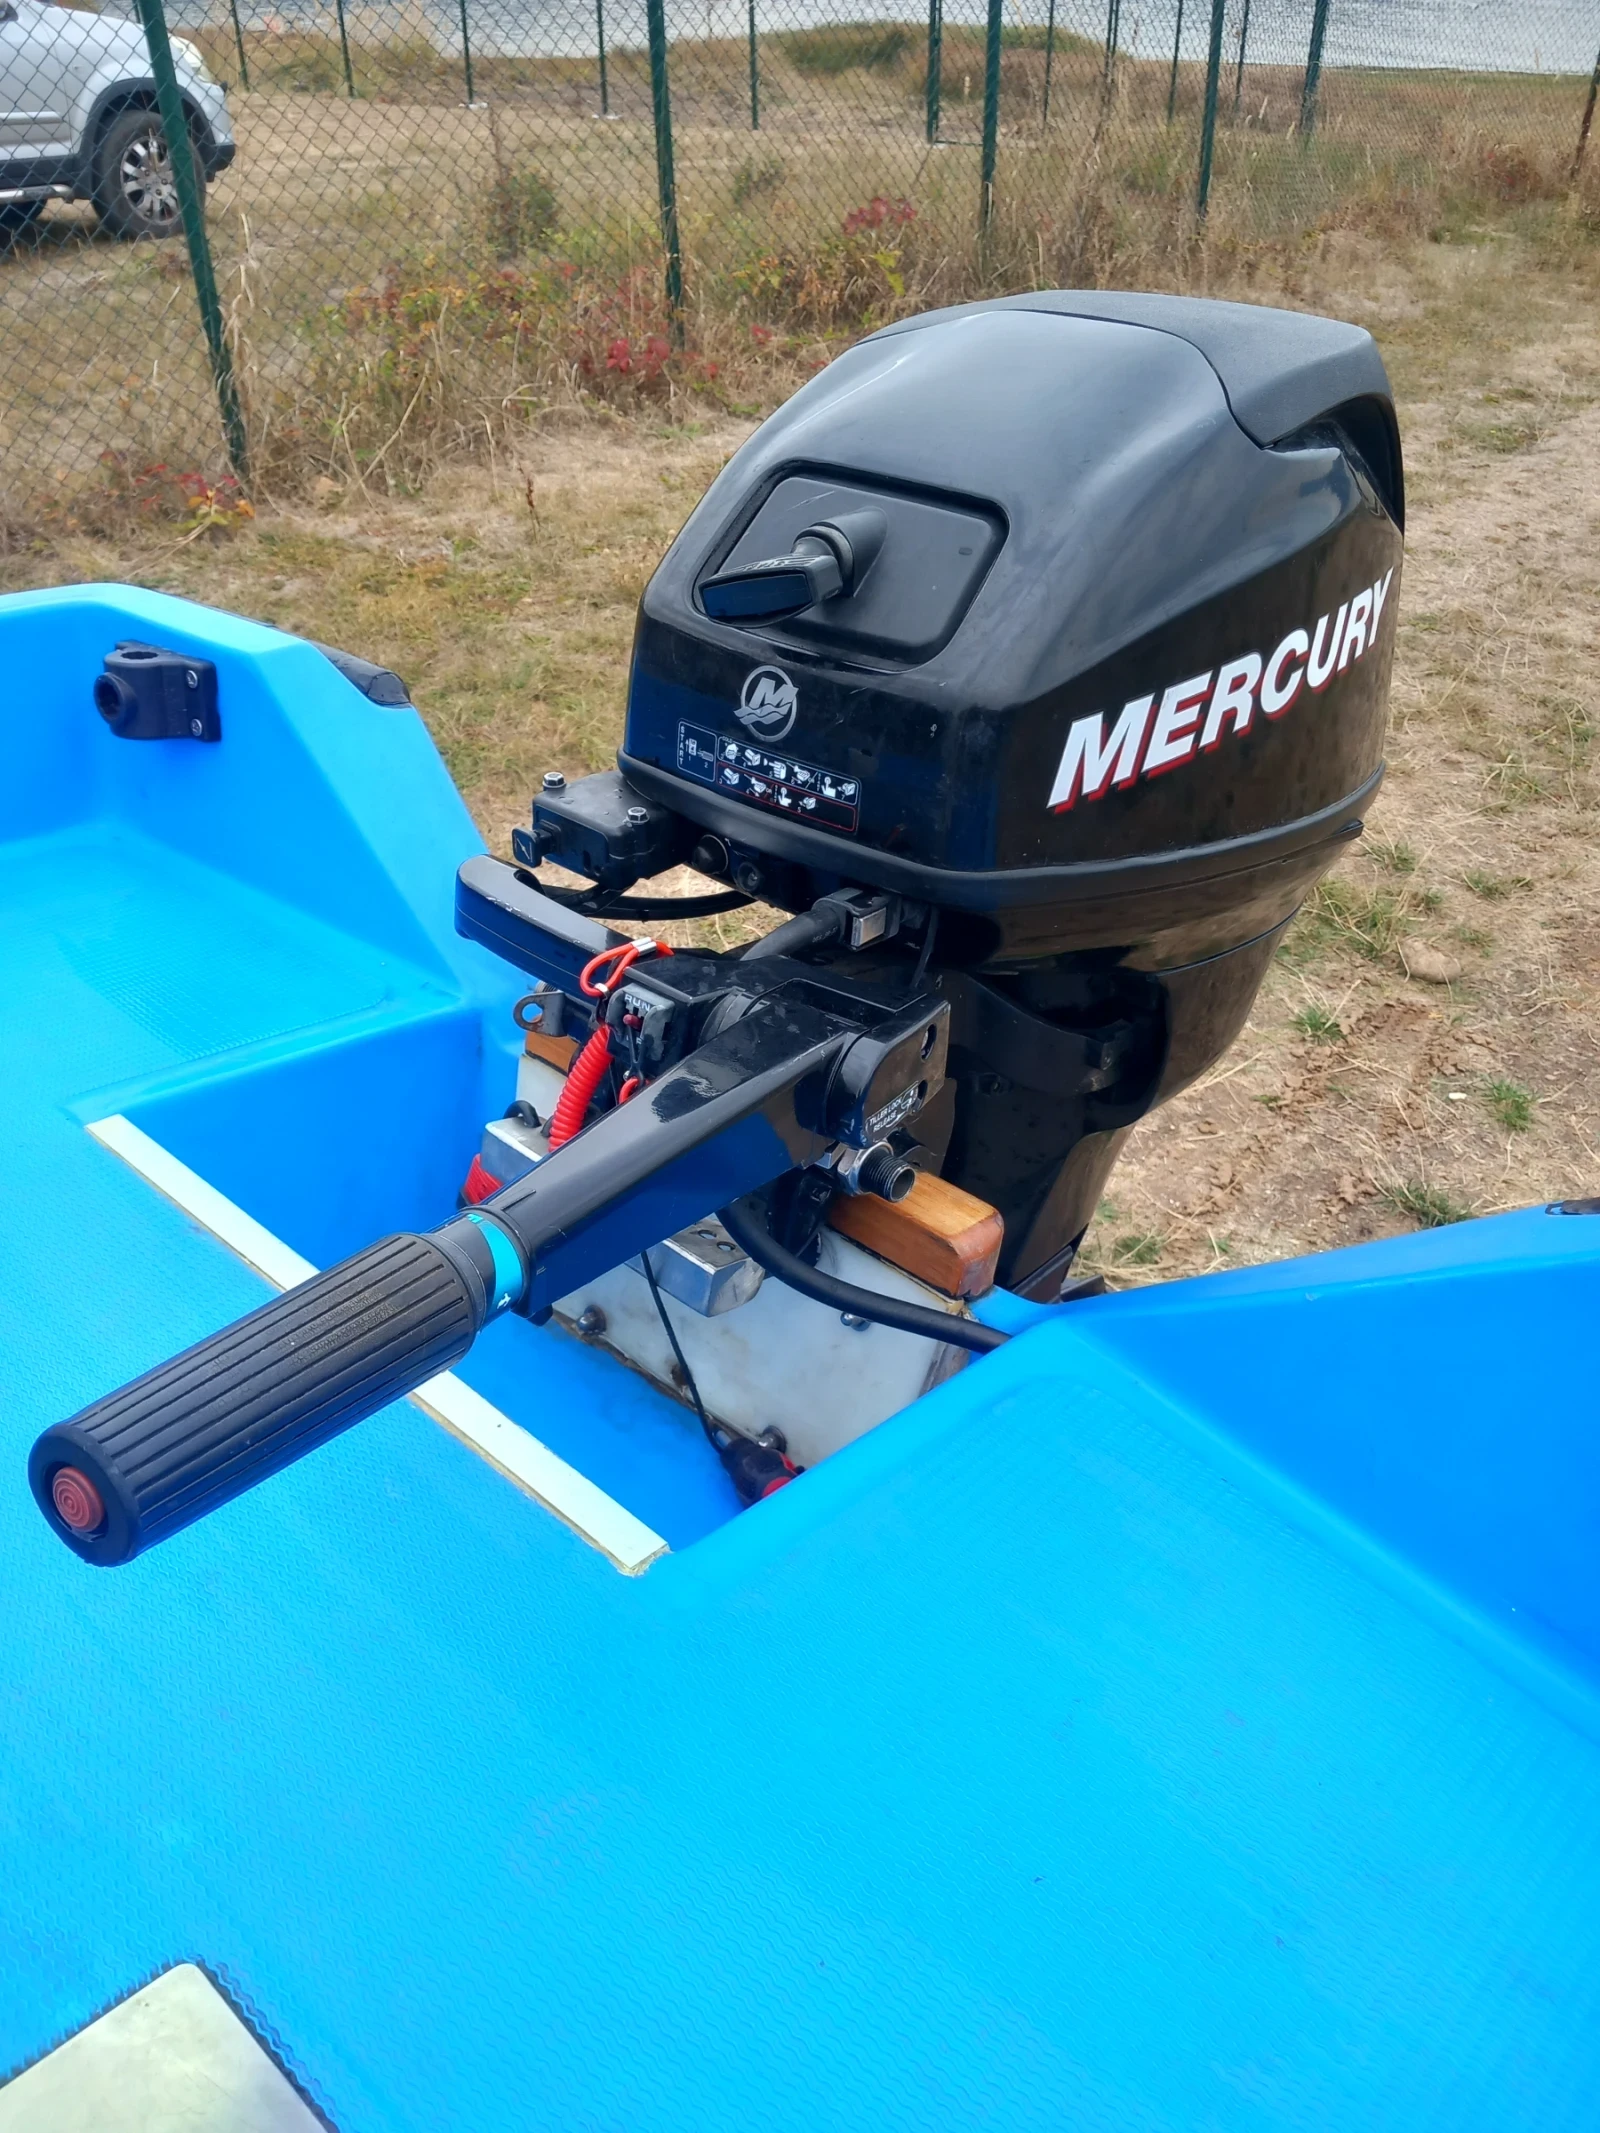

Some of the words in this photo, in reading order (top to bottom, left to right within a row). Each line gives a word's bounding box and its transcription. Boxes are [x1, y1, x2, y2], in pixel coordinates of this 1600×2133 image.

[1046, 566, 1394, 813] MERCURY
[624, 993, 651, 1012] RUN
[869, 1107, 889, 1126] TILLER
[872, 1109, 898, 1133] RELEASE
